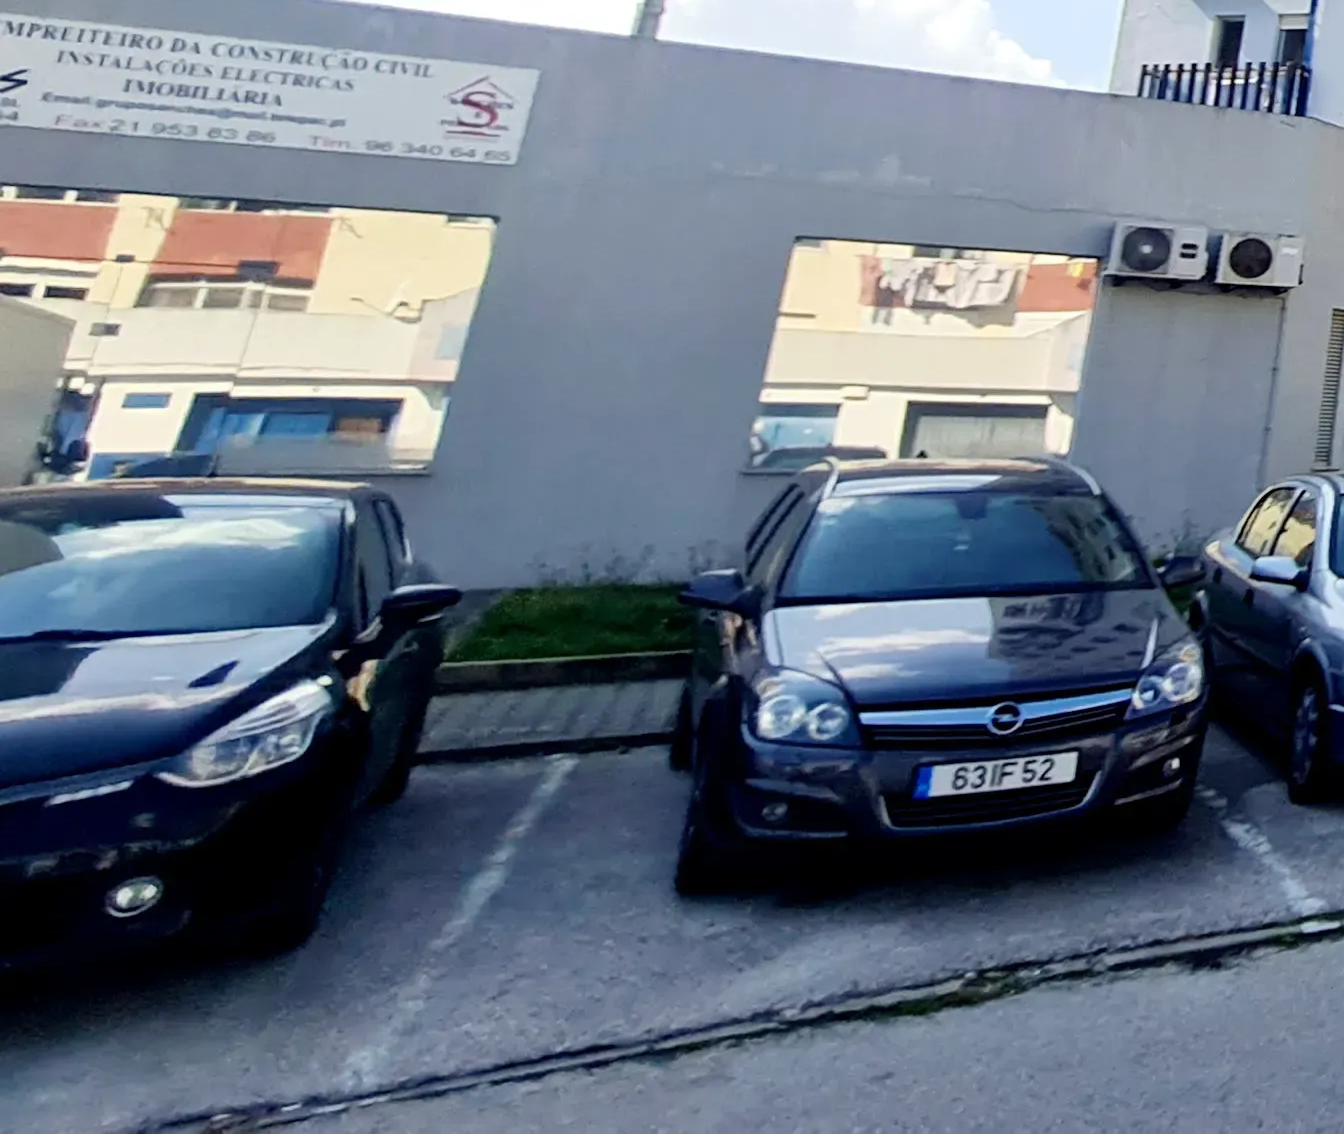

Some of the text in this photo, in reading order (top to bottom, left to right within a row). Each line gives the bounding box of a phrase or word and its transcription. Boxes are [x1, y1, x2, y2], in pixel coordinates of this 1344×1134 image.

[0, 19, 434, 78] MPREITEIRO DA CONSTRUÇÃO CIVIL
[220, 65, 355, 91] ELECTRICAS
[123, 78, 283, 106] IMOBILIÁRIA
[109, 119, 139, 133] 21
